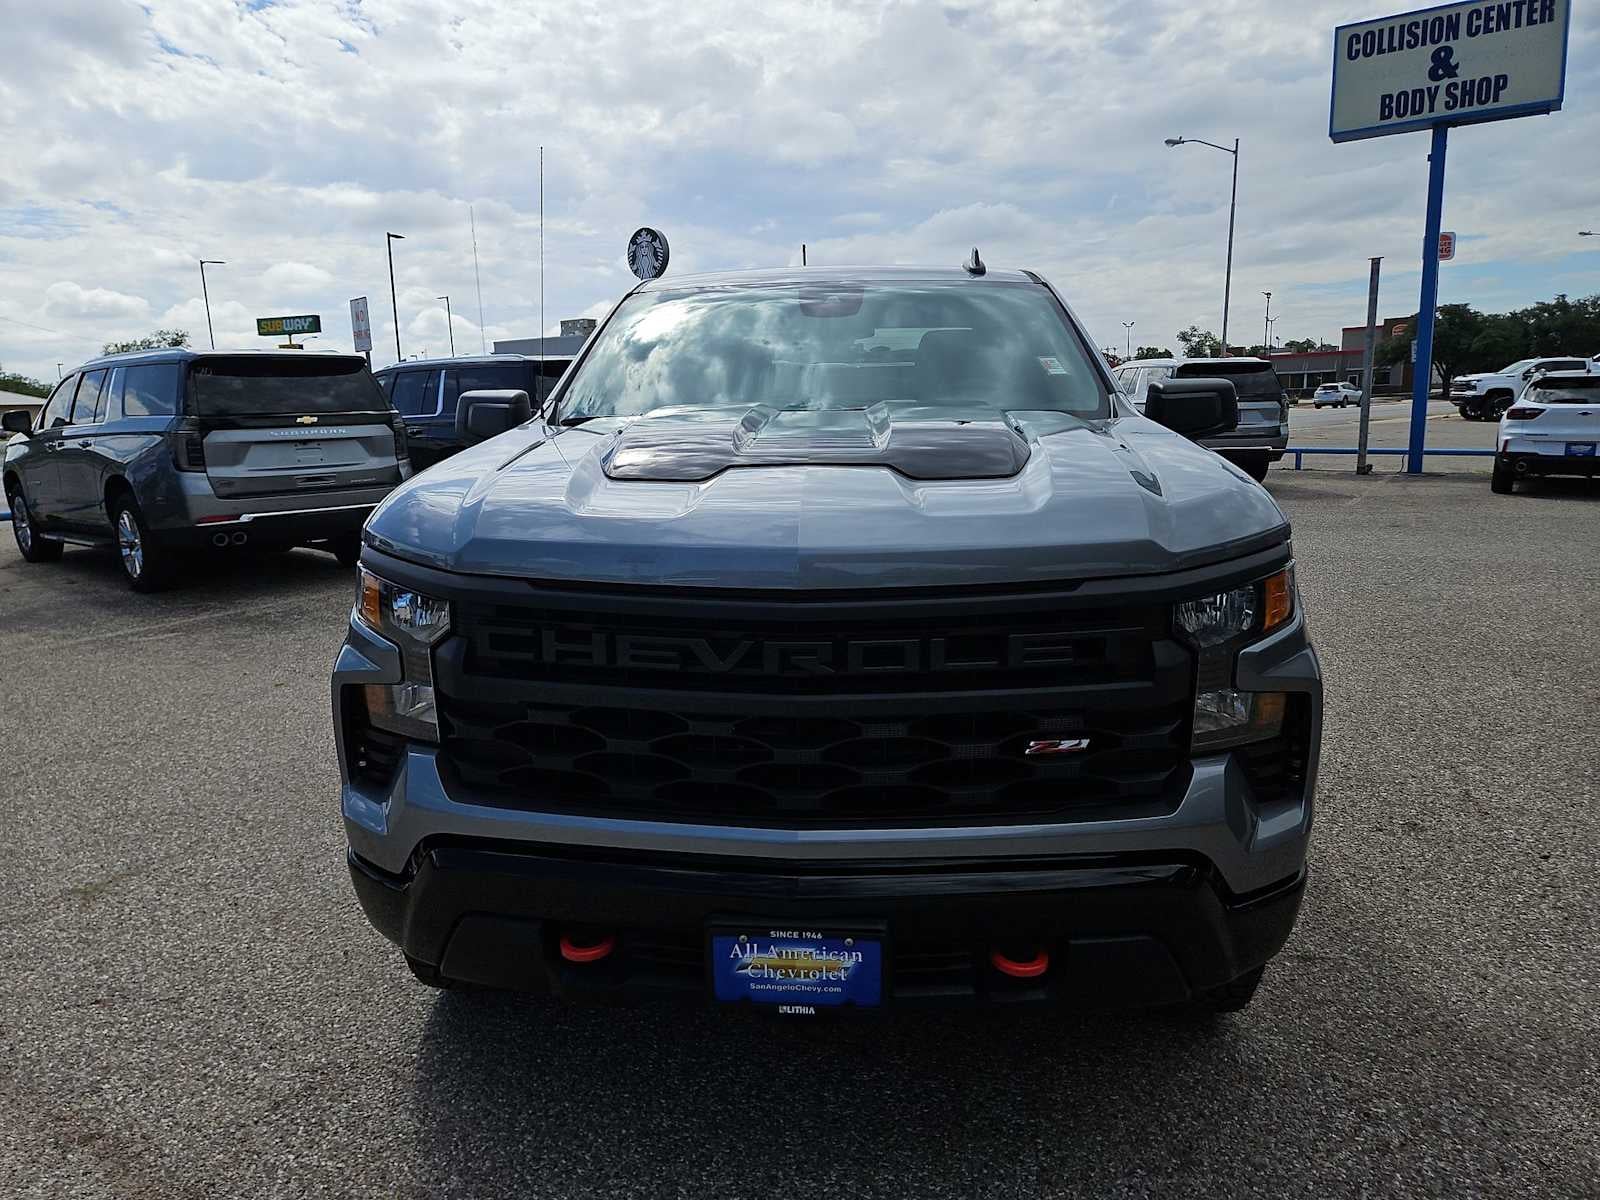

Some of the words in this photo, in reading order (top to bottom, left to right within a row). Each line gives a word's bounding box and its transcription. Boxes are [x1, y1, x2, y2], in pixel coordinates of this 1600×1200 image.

[1347, 12, 1461, 61] COLLISION
[1466, 0, 1555, 38] CENTER
[1428, 45, 1460, 82] &
[1379, 85, 1440, 121] BODY
[1444, 74, 1509, 111] SHOP
[260, 318, 312, 332] SUBWAY
[476, 624, 1145, 674] CHEVROLET
[1024, 738, 1091, 755] Z71
[769, 930, 800, 939] SINCE
[729, 943, 758, 959] All
[767, 944, 864, 962] American
[747, 963, 848, 981] Chevrolet
[750, 982, 842, 993] SanAngeloChevy.com
[787, 1005, 816, 1015] LITHIA
